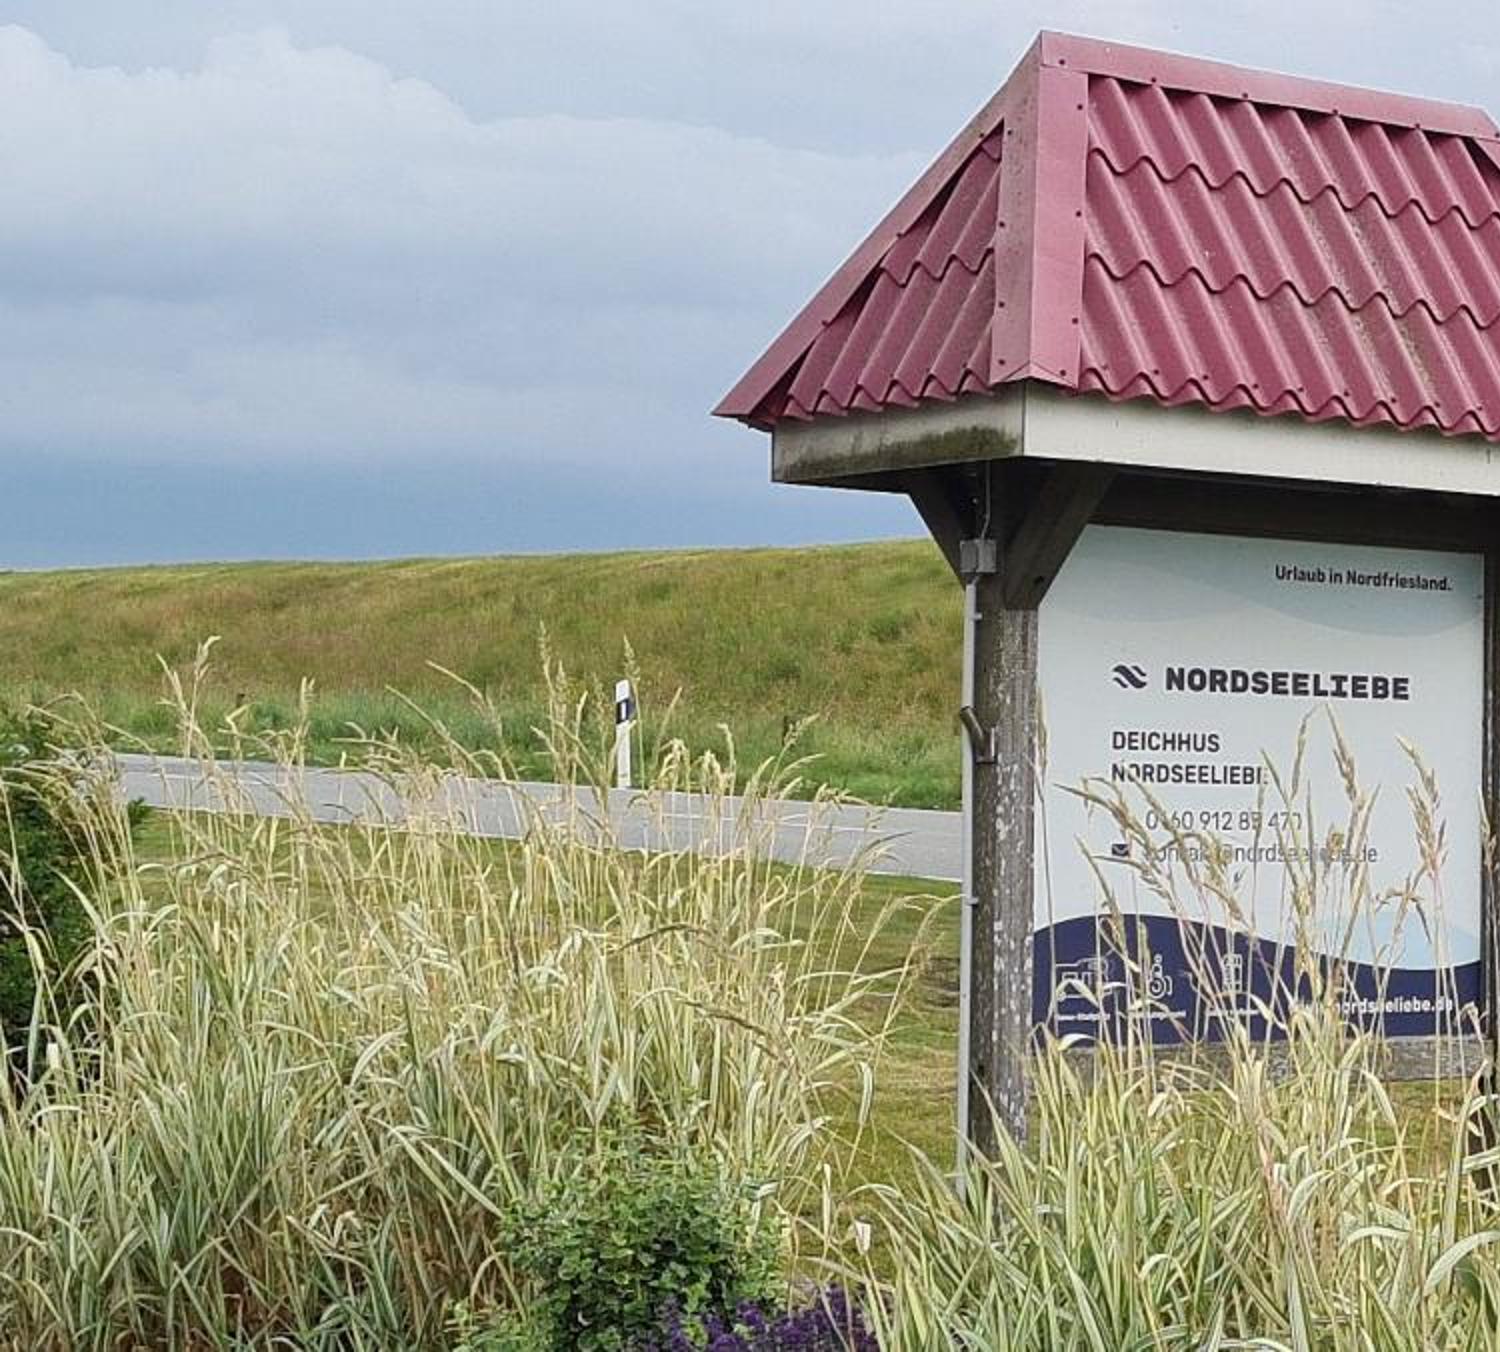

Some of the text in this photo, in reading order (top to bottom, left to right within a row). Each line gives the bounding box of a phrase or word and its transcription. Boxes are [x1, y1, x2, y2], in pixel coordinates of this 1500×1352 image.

[1275, 564, 1453, 591] Urlaub in Nordfriesland.
[1165, 667, 1409, 700] NORDSEELIEBE
[1112, 731, 1220, 752] DEICHHUS
[1111, 763, 1268, 785] NORDSEELIEBE
[1146, 809, 1194, 830] 060
[1200, 811, 1233, 831] 912
